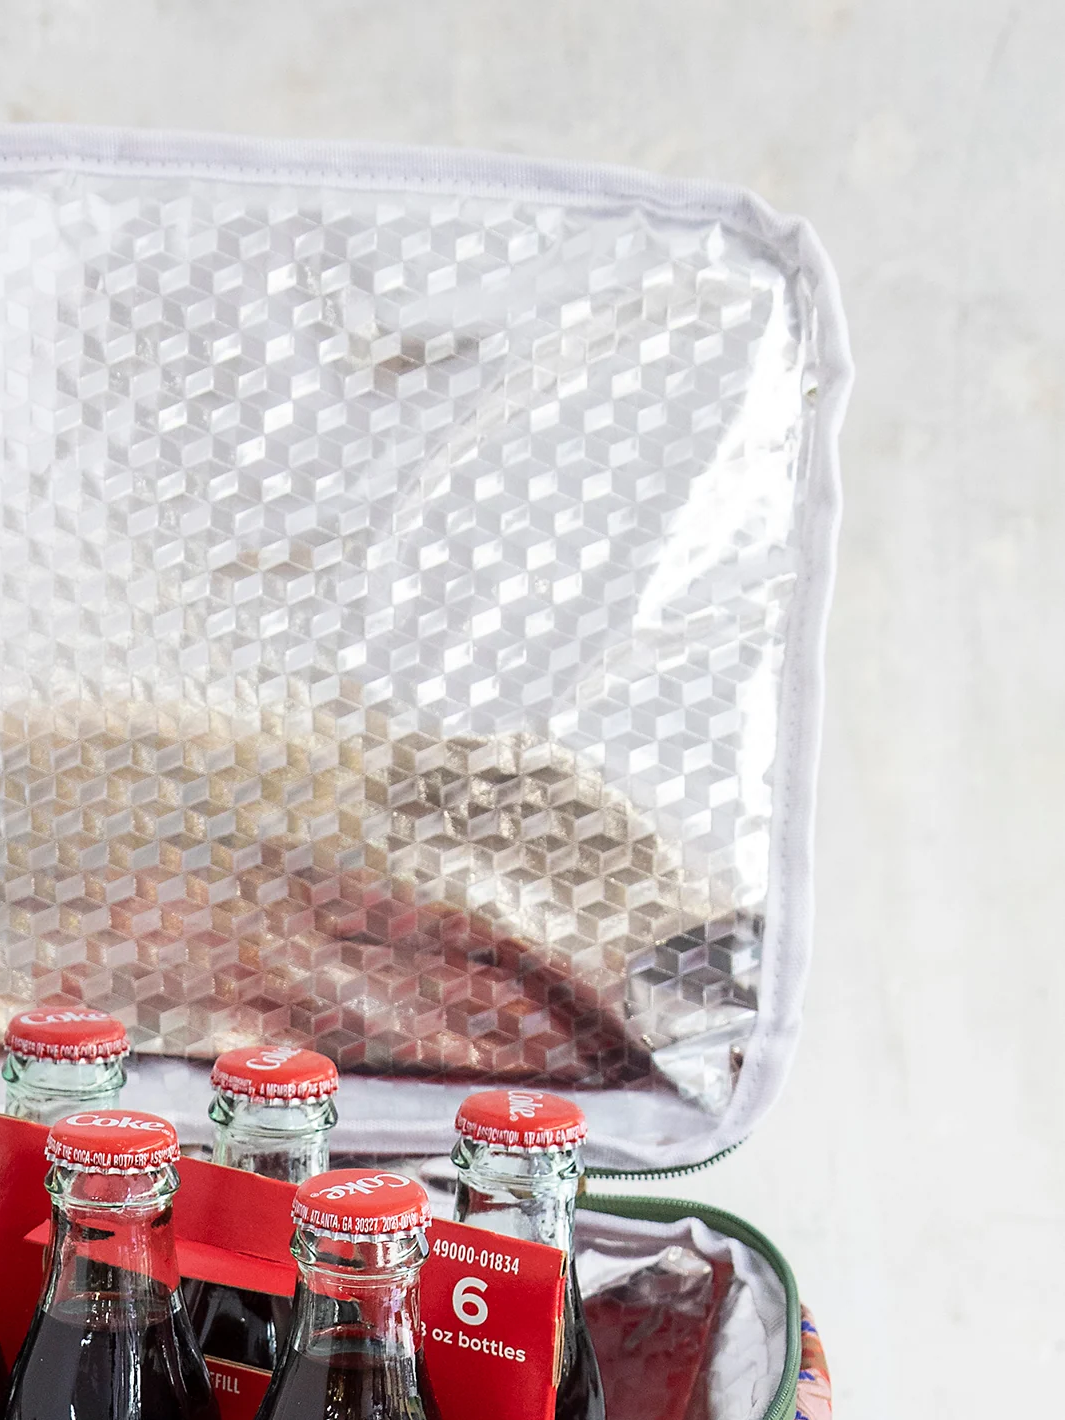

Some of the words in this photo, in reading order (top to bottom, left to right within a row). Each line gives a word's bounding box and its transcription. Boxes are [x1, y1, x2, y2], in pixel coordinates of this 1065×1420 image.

[19, 1011, 109, 1026] Coke
[507, 1090, 543, 1118] Coke
[66, 1114, 166, 1132] Coke
[73, 1148, 112, 1167] COCA-COLA
[318, 1173, 411, 1200] Coke
[310, 1209, 341, 1229] ATLANTA,
[342, 1216, 353, 1231] GA
[355, 1217, 379, 1233] 30327
[433, 1238, 520, 1275] 49000-01834
[452, 1276, 489, 1326] 6
[432, 1327, 453, 1344] oz
[458, 1331, 527, 1363] bottles
